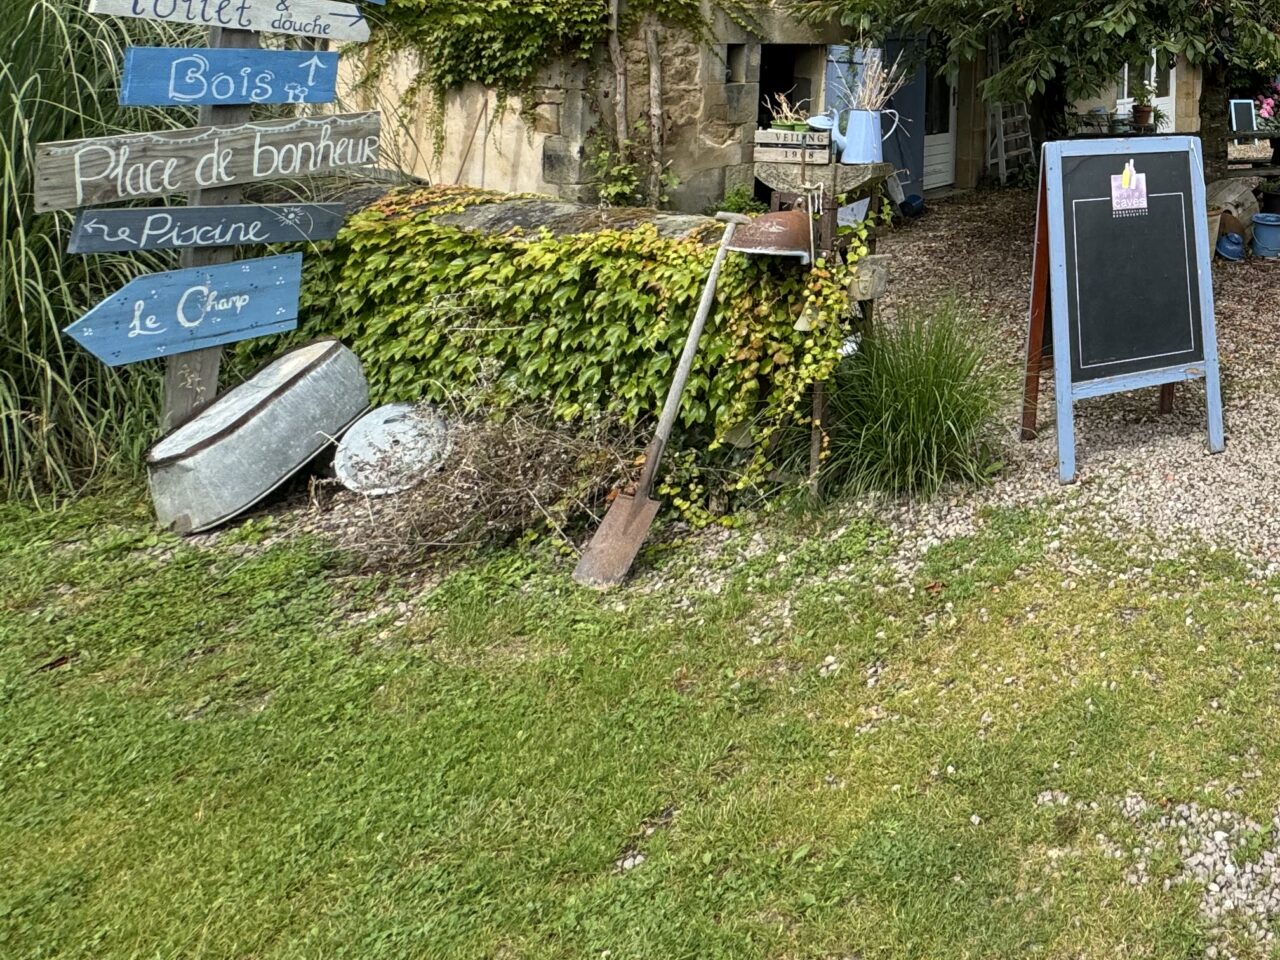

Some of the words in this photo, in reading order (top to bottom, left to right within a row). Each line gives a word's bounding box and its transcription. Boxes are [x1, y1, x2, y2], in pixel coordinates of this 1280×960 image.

[271, 13, 331, 35] douche
[168, 53, 275, 103] Bois
[775, 132, 824, 143] VEILNG
[784, 150, 814, 159] 198
[73, 145, 182, 205] Place
[195, 138, 236, 186] de
[138, 212, 270, 248] Piscine
[128, 300, 167, 337] Le
[176, 285, 250, 328] Champ
